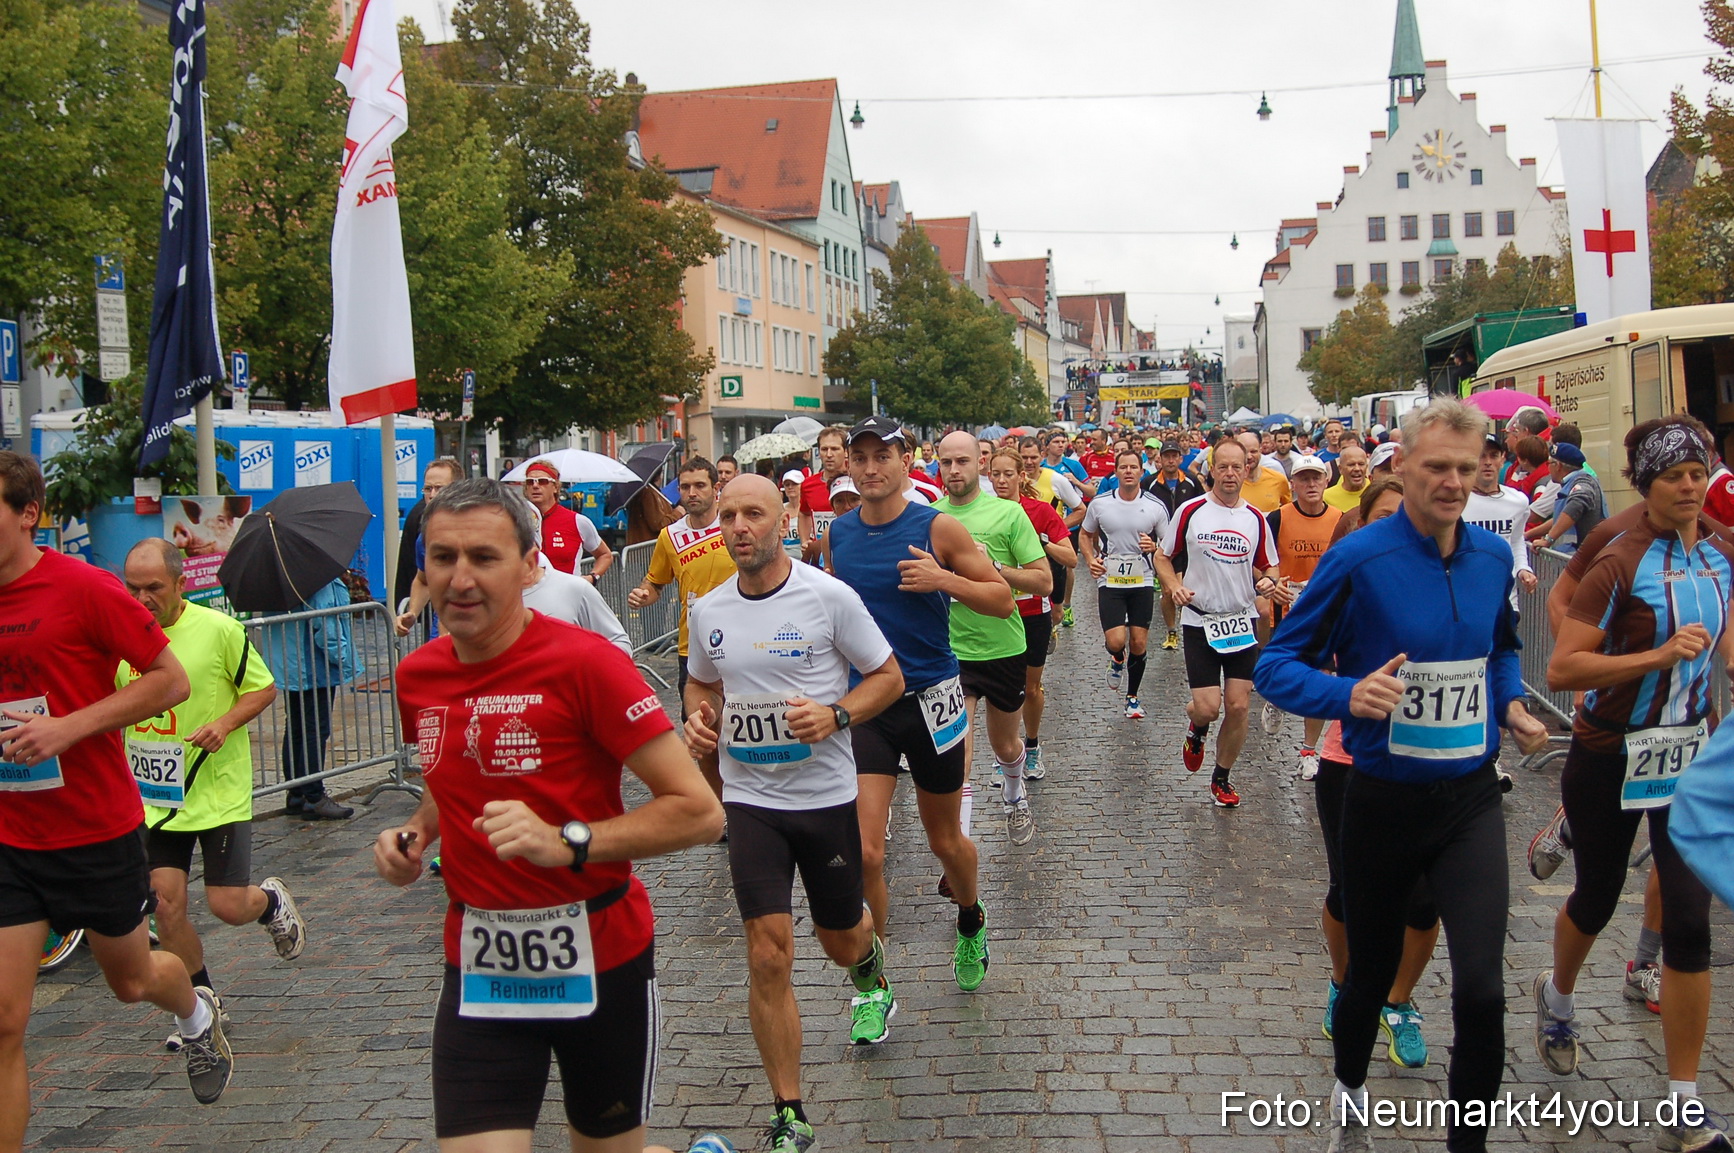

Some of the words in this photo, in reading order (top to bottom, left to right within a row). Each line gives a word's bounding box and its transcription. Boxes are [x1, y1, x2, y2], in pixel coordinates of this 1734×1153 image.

[2, 328, 14, 375] P
[235, 356, 246, 385] P
[1555, 363, 1605, 393] Bayerisches
[723, 378, 740, 395] D
[1127, 389, 1159, 398] START
[1555, 394, 1579, 414] Rotes
[1464, 519, 1512, 535] ULE
[1197, 533, 1242, 545] GERHART
[1217, 542, 1248, 553] JANIG
[679, 545, 708, 567] MAX
[1118, 562, 1133, 576] 47
[194, 574, 217, 586] GRÜN
[1209, 617, 1249, 638] 3025
[1399, 668, 1434, 682] PARTL
[1436, 670, 1476, 682] Neumarkt
[464, 697, 476, 707] 11.
[476, 694, 543, 706] NEUMARKTER
[747, 700, 789, 711] Neumarkt
[1402, 683, 1480, 722] 3174
[472, 703, 527, 715] STADTLAUF
[1628, 736, 1661, 748] PARTL
[140, 746, 171, 756] Neumarkt
[494, 746, 541, 757] 19.09.2010
[745, 750, 791, 762] Thomas
[1633, 740, 1700, 777] 2197
[131, 753, 178, 783] 2952
[466, 909, 495, 923] PARTL
[496, 909, 563, 923] Neumarkt
[472, 925, 579, 973] 2963
[490, 980, 566, 999] Reinhard
